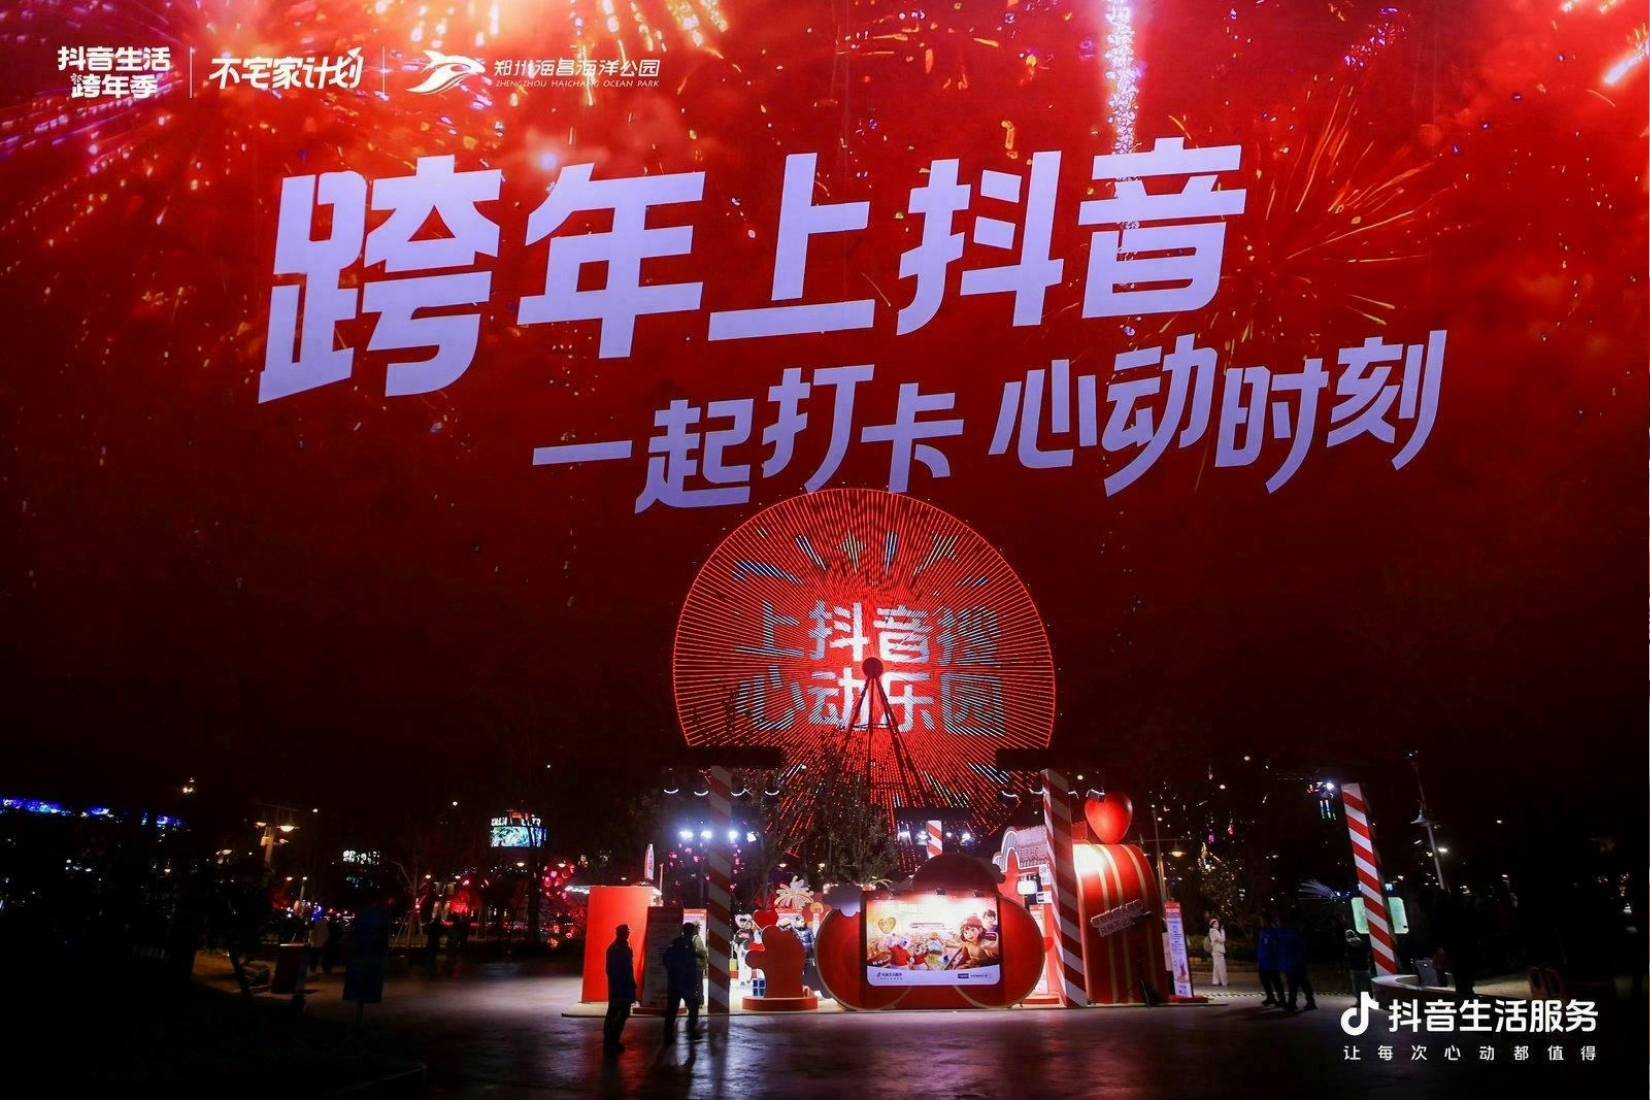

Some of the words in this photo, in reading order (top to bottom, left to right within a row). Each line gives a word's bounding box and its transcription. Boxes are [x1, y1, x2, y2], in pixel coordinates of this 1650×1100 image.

[258, 136, 1248, 403] 跨年上抖音
[531, 362, 965, 513] 一起打卡
[990, 329, 1449, 497] 心动时刻
[735, 666, 1006, 737] 心动乐园
